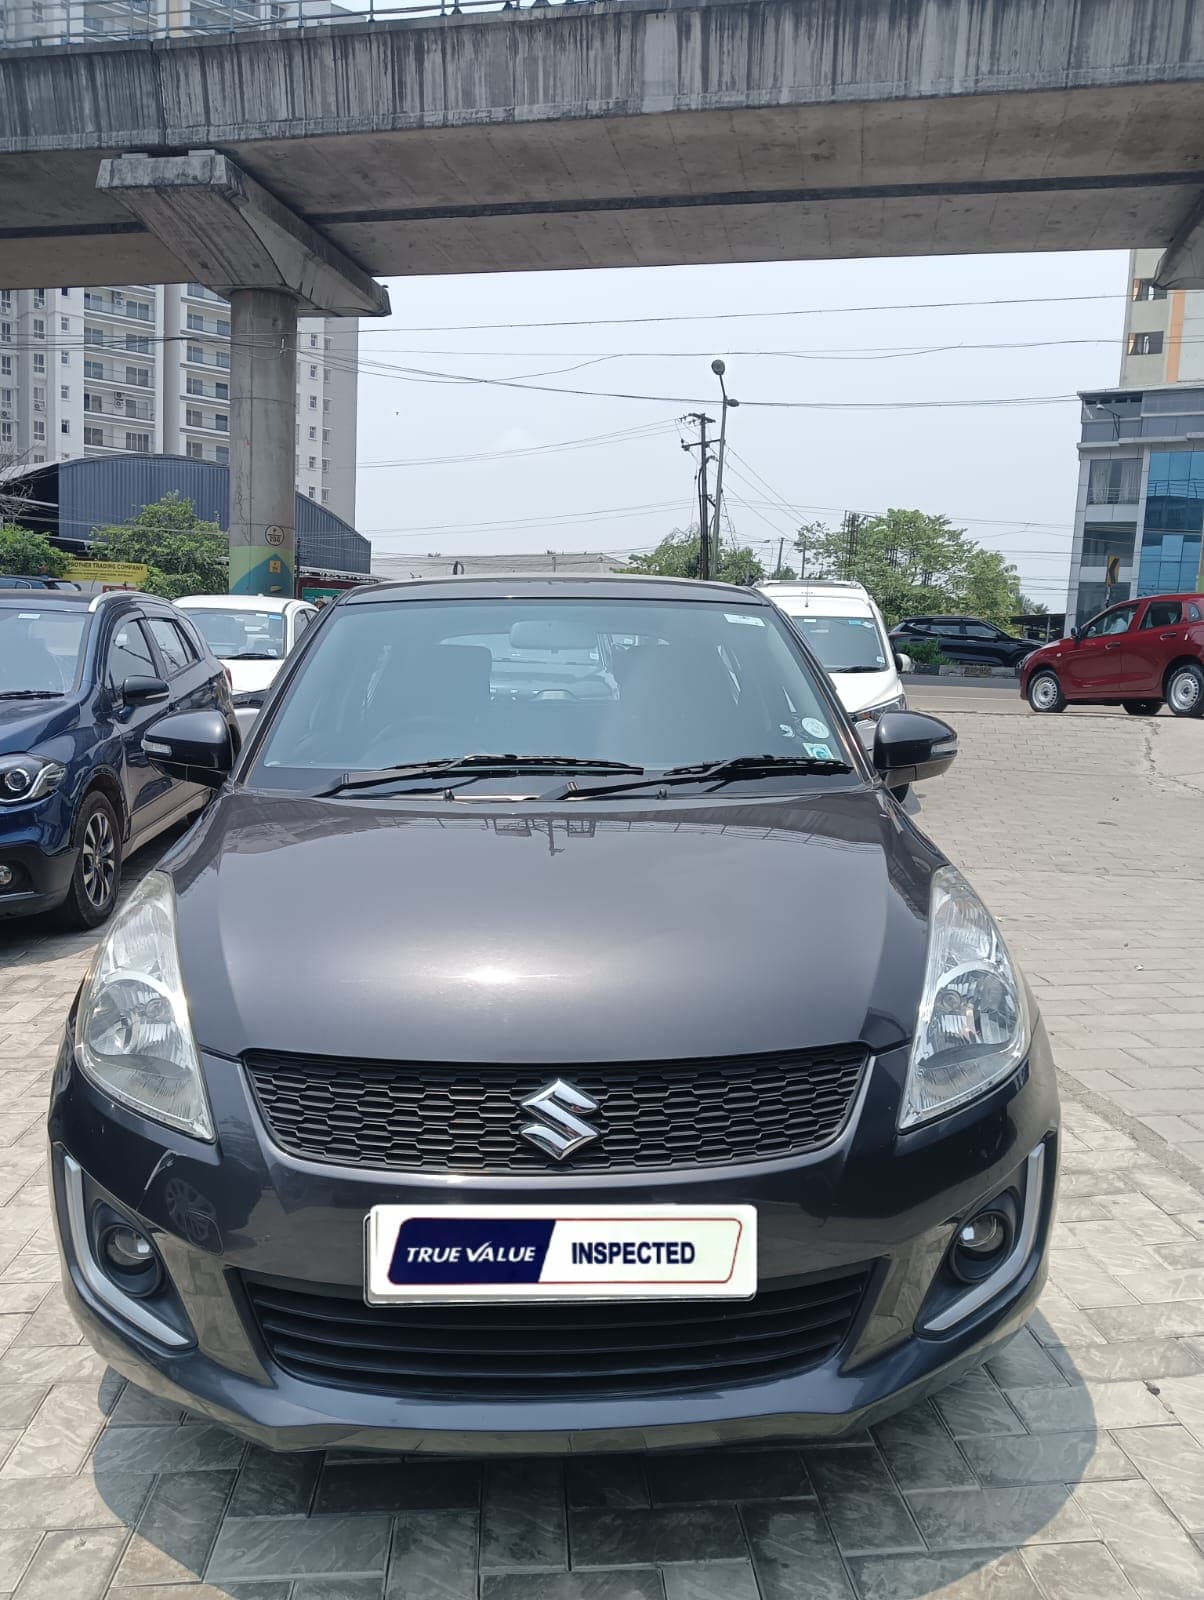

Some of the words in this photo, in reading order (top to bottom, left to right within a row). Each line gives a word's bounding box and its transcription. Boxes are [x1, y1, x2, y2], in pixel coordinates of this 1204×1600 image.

[93, 562, 116, 570] TRADING
[407, 1247, 462, 1263] TRUE
[466, 1241, 536, 1263] VALUE
[571, 1241, 696, 1265] INSPECTED
